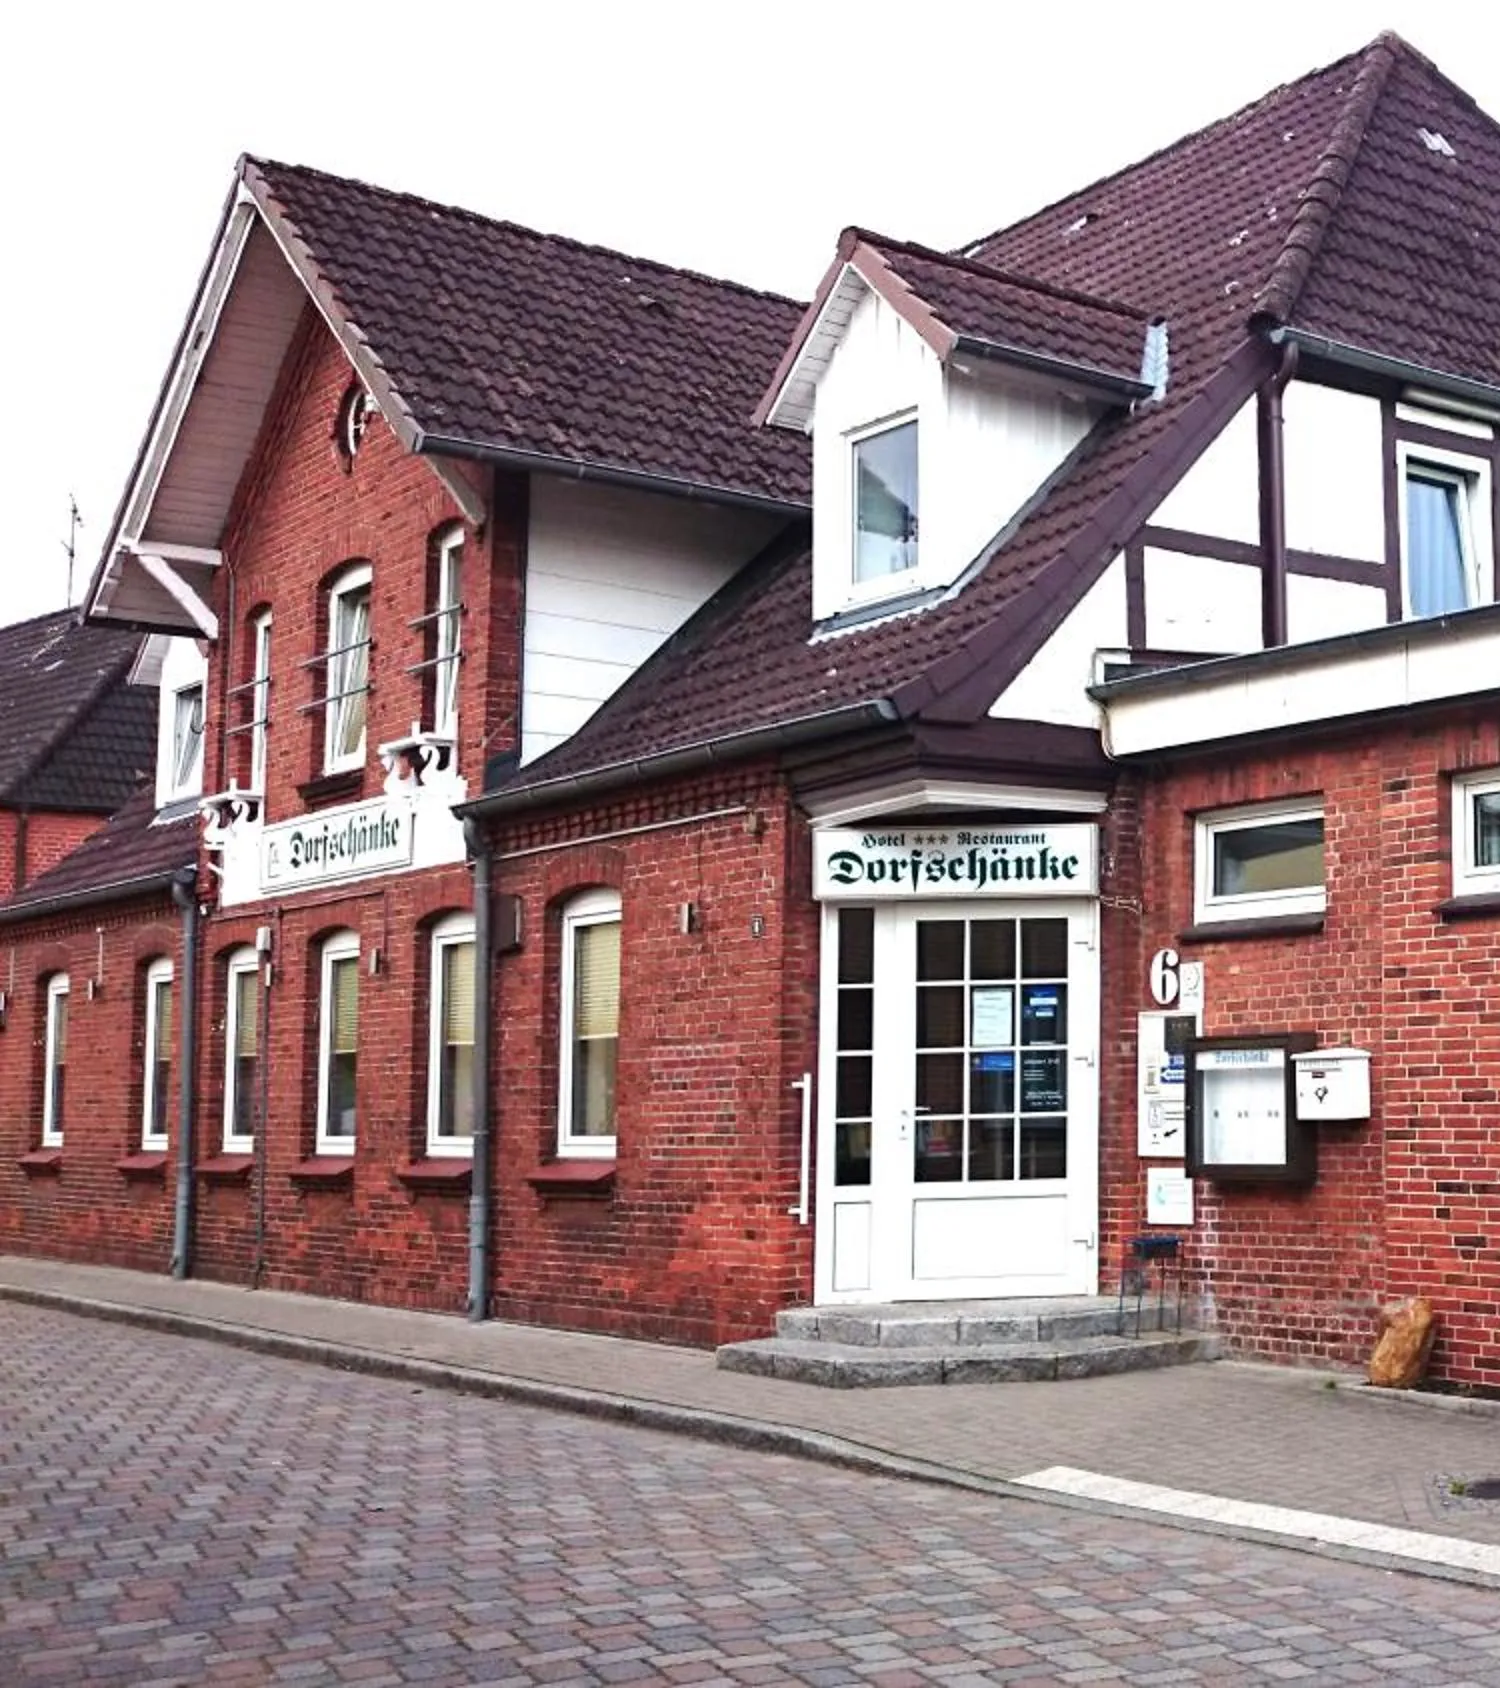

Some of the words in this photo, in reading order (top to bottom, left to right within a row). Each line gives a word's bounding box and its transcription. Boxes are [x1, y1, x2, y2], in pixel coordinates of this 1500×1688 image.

[290, 809, 400, 872] Dorfschänke
[861, 833, 906, 849] Hotel
[957, 831, 1047, 846] Restaurant
[827, 846, 1079, 893] Dorfschänke
[1150, 949, 1180, 1005] 6
